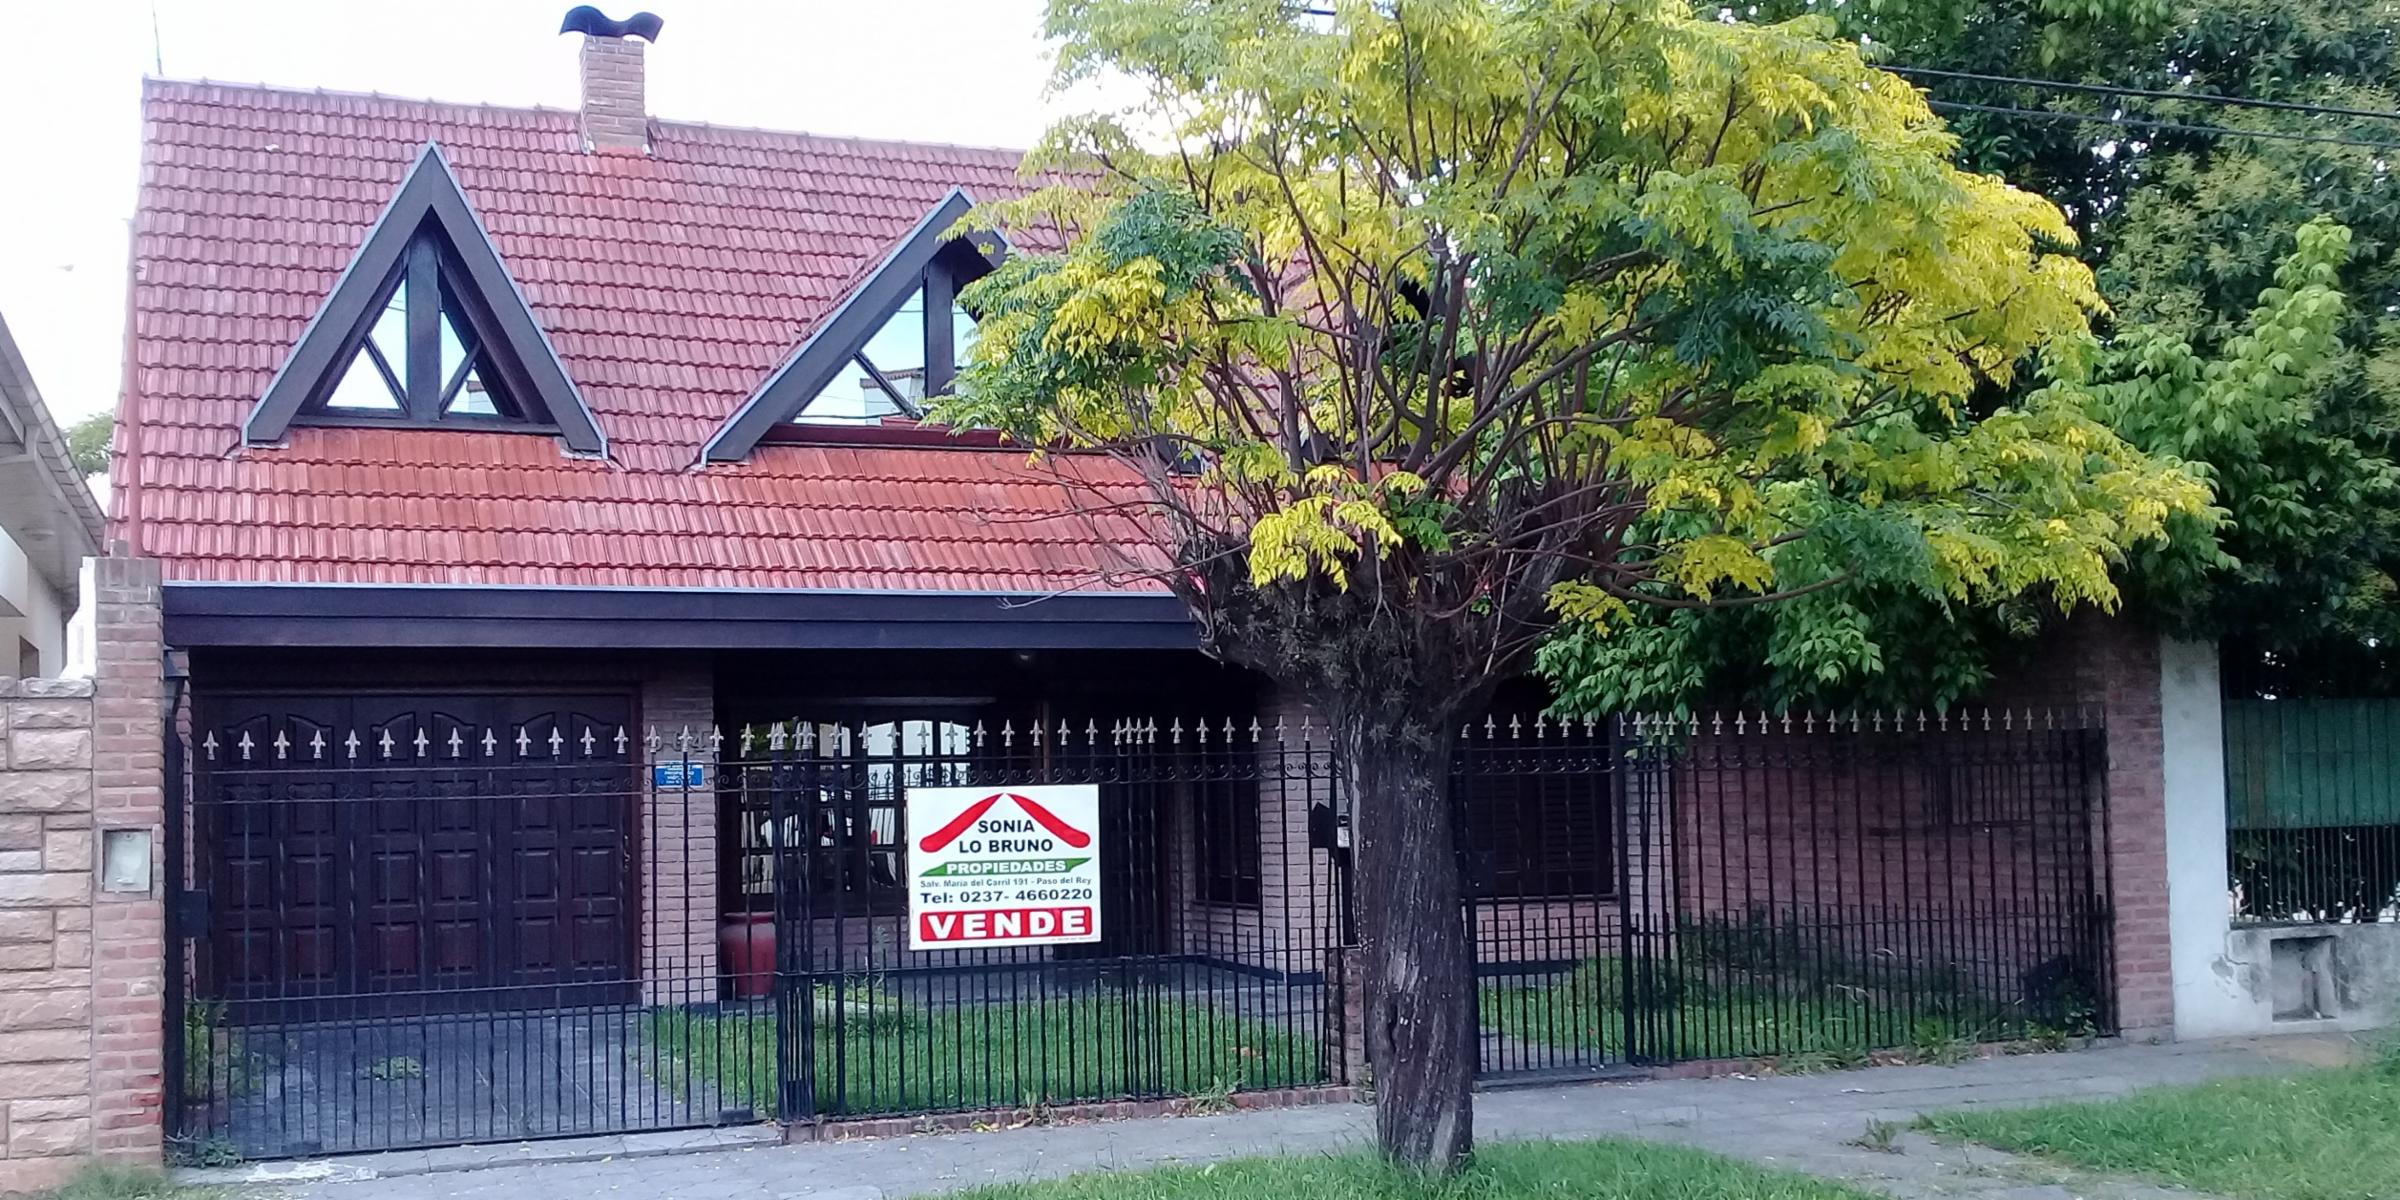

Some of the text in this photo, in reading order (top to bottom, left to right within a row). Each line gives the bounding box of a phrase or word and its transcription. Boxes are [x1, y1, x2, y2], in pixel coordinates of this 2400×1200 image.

[978, 820, 1035, 833] SONIA
[959, 839, 1053, 853] LO BRUNO
[947, 861, 1066, 874] PROPIEDADES
[1037, 877, 1057, 885] Paso
[1076, 877, 1091, 885] Rey
[920, 893, 953, 904] Tel:
[1016, 889, 1092, 901] 4660220
[928, 910, 1085, 939] VENDE
